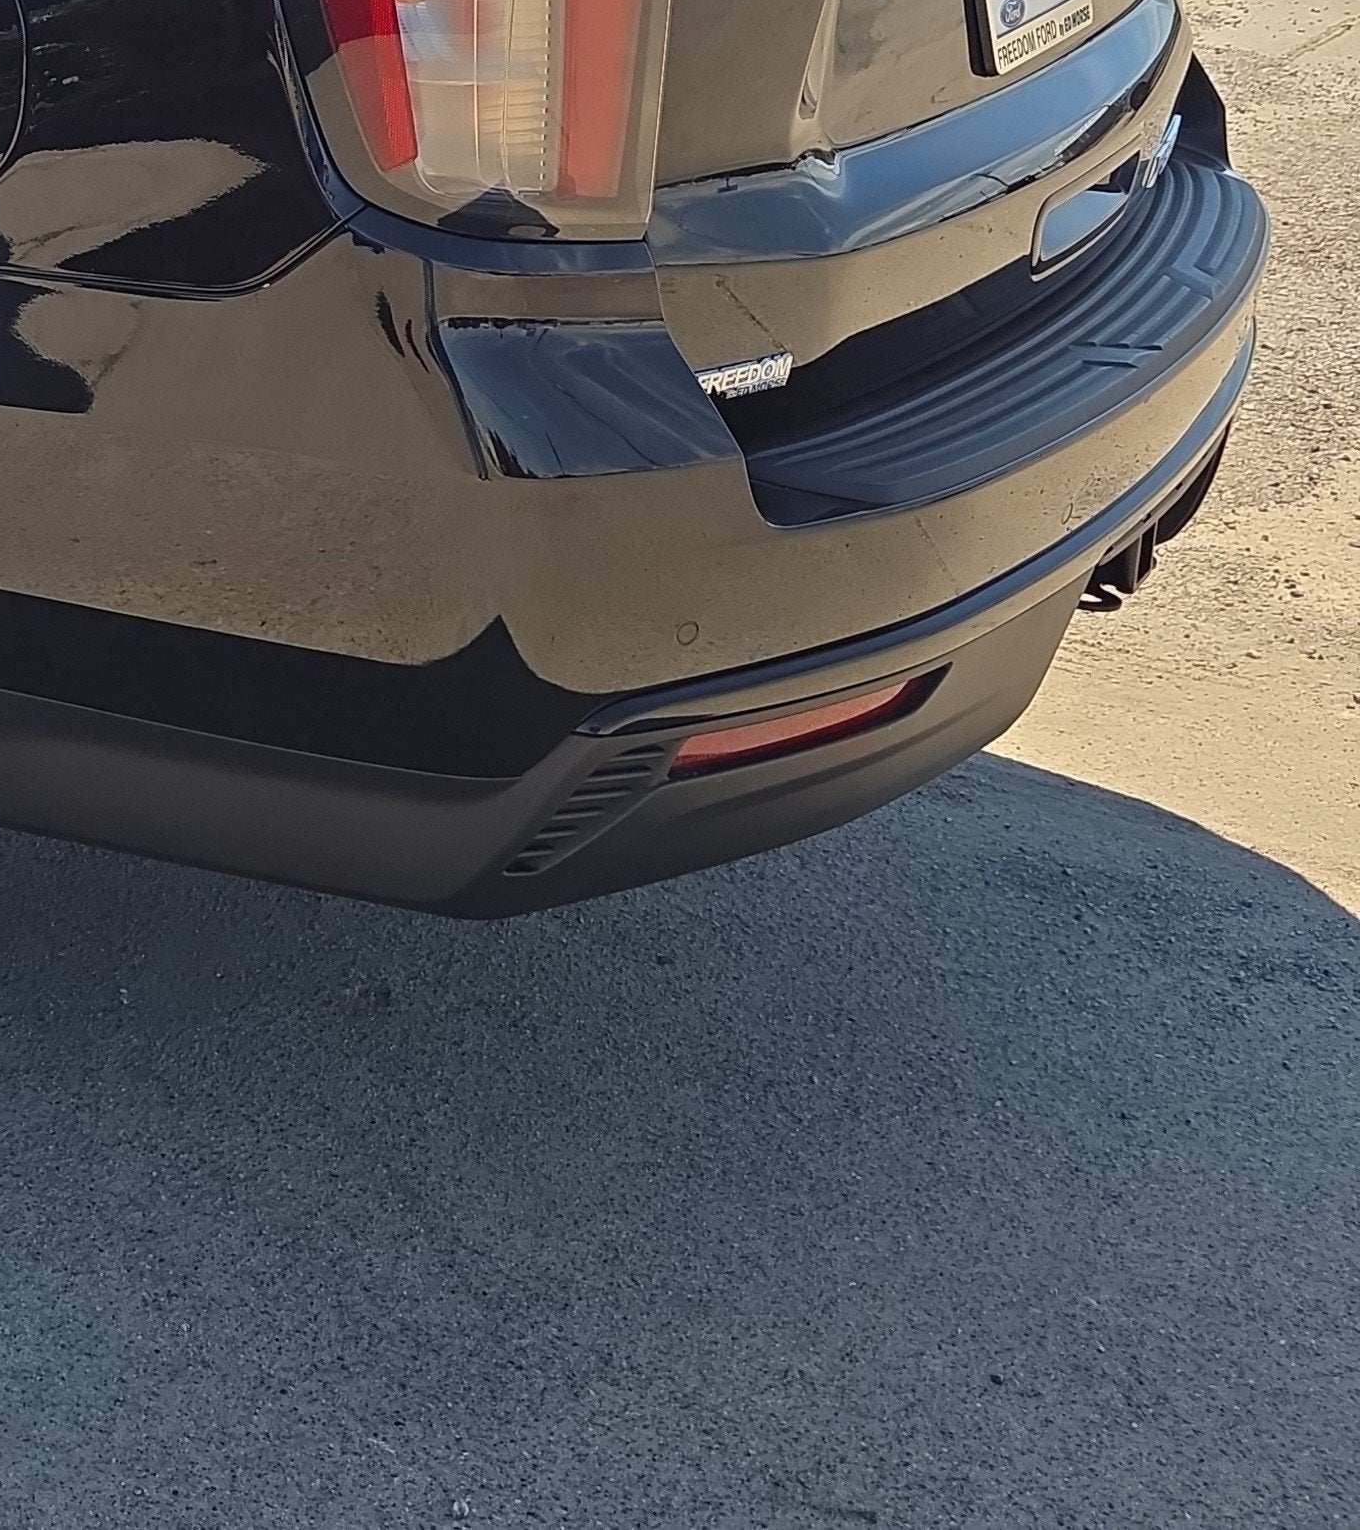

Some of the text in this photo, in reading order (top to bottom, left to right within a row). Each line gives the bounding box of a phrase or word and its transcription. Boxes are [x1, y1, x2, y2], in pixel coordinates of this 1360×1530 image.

[997, 31, 1037, 70] FREEDOM
[1036, 20, 1057, 48] FORD
[698, 352, 794, 395] FREEDOM
